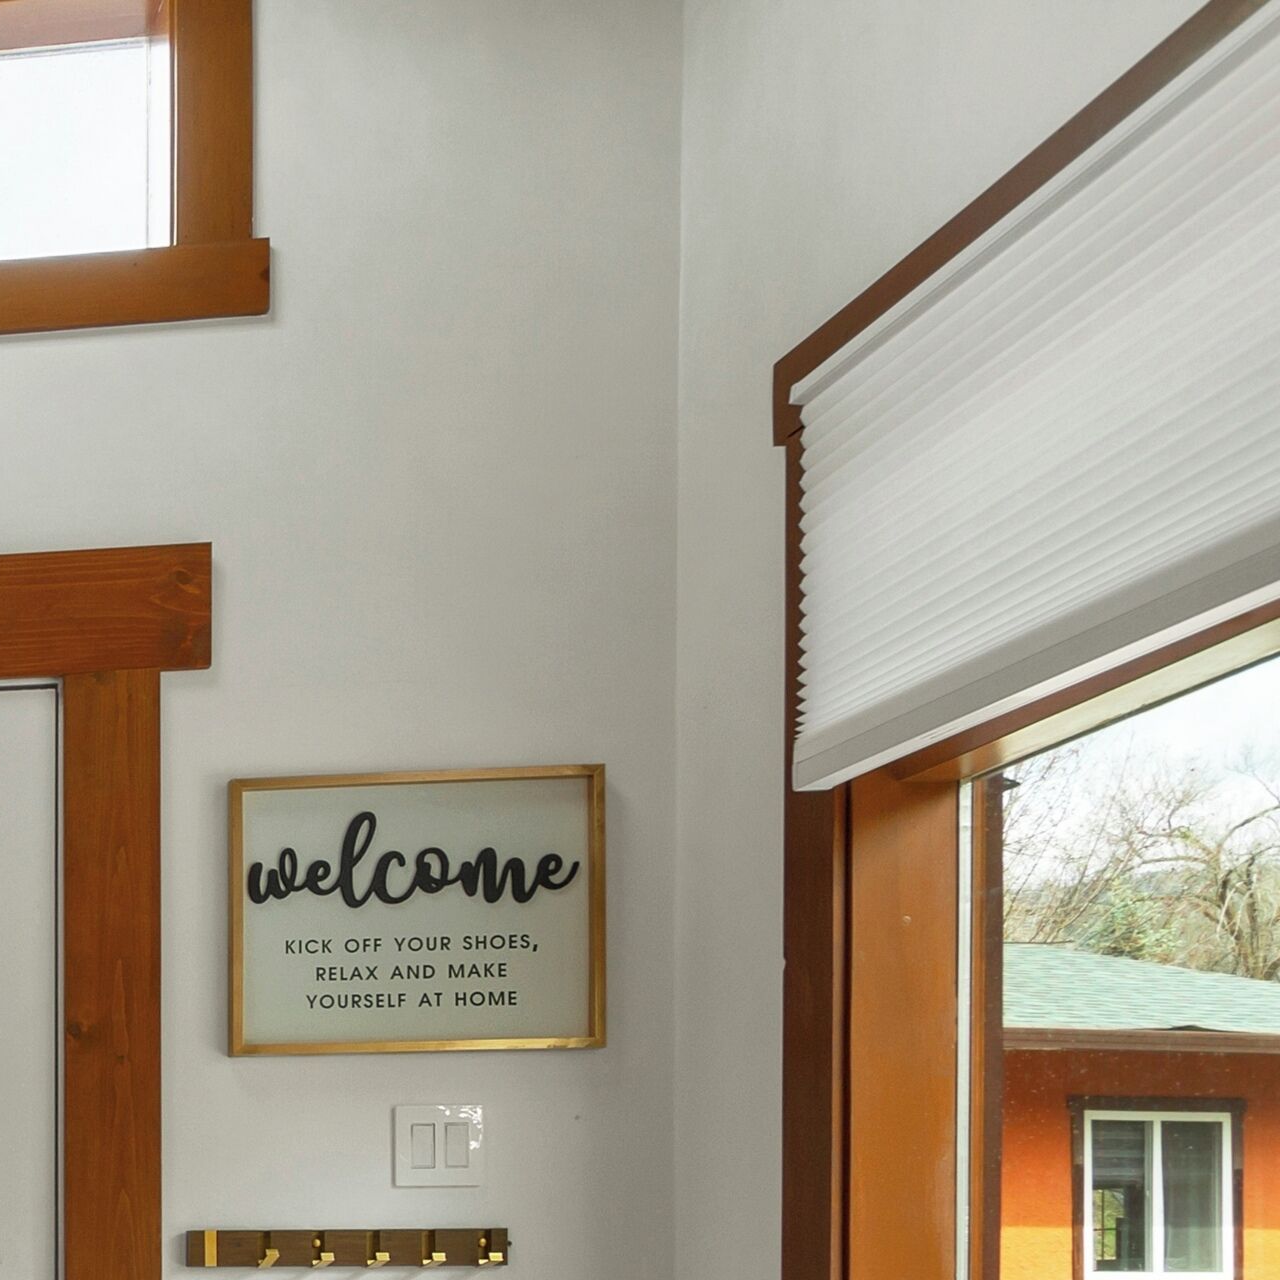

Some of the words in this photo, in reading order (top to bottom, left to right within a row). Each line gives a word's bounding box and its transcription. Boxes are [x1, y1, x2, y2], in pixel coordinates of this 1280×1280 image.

[248, 811, 580, 908] welcome
[285, 938, 333, 955] KICK
[344, 937, 383, 954] OFF
[393, 935, 452, 953] YOUR
[462, 933, 539, 952] SHOES,
[316, 965, 379, 982] RELAX
[389, 964, 436, 981] AND
[448, 962, 509, 980] MAKE
[305, 992, 407, 1010] YOURSELF
[417, 991, 444, 1008] AT
[454, 990, 518, 1007] HOME
